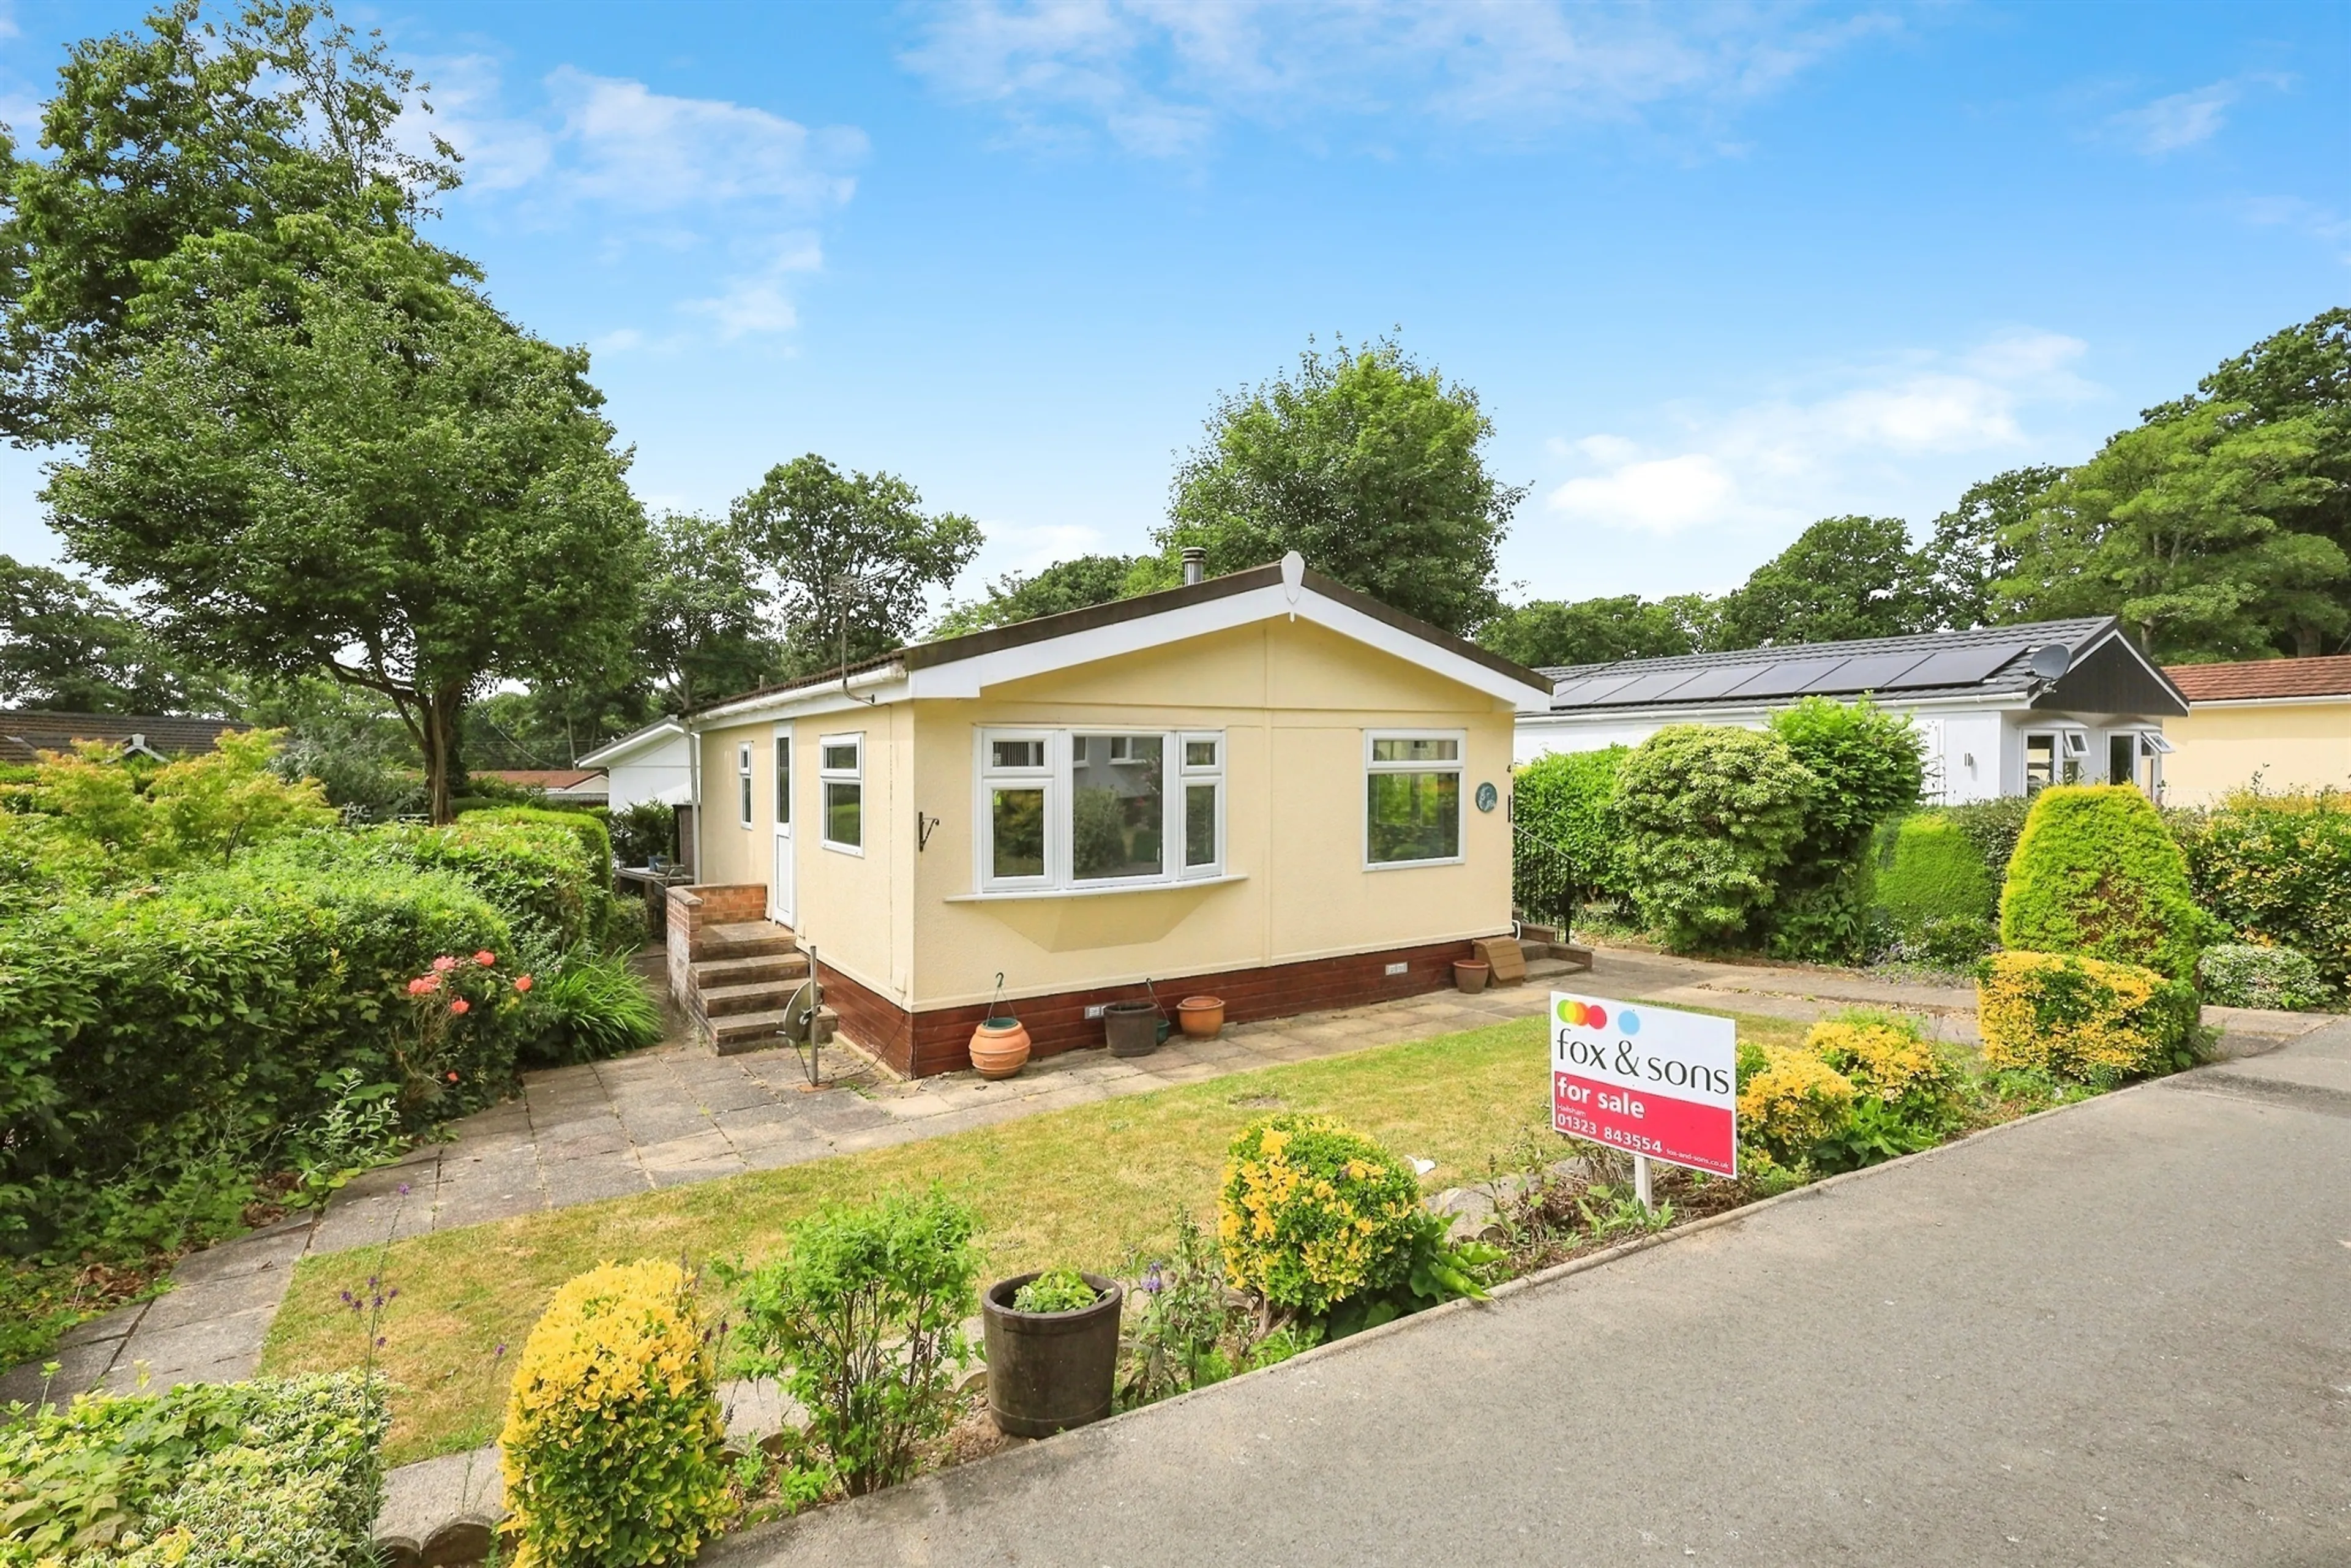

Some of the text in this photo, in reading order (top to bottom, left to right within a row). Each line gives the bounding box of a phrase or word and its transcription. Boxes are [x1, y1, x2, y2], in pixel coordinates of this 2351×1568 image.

[1556, 1028, 1730, 1095] fox & sons
[1557, 1076, 1646, 1119] for sale
[1557, 1113, 1663, 1153] 01323 843554
